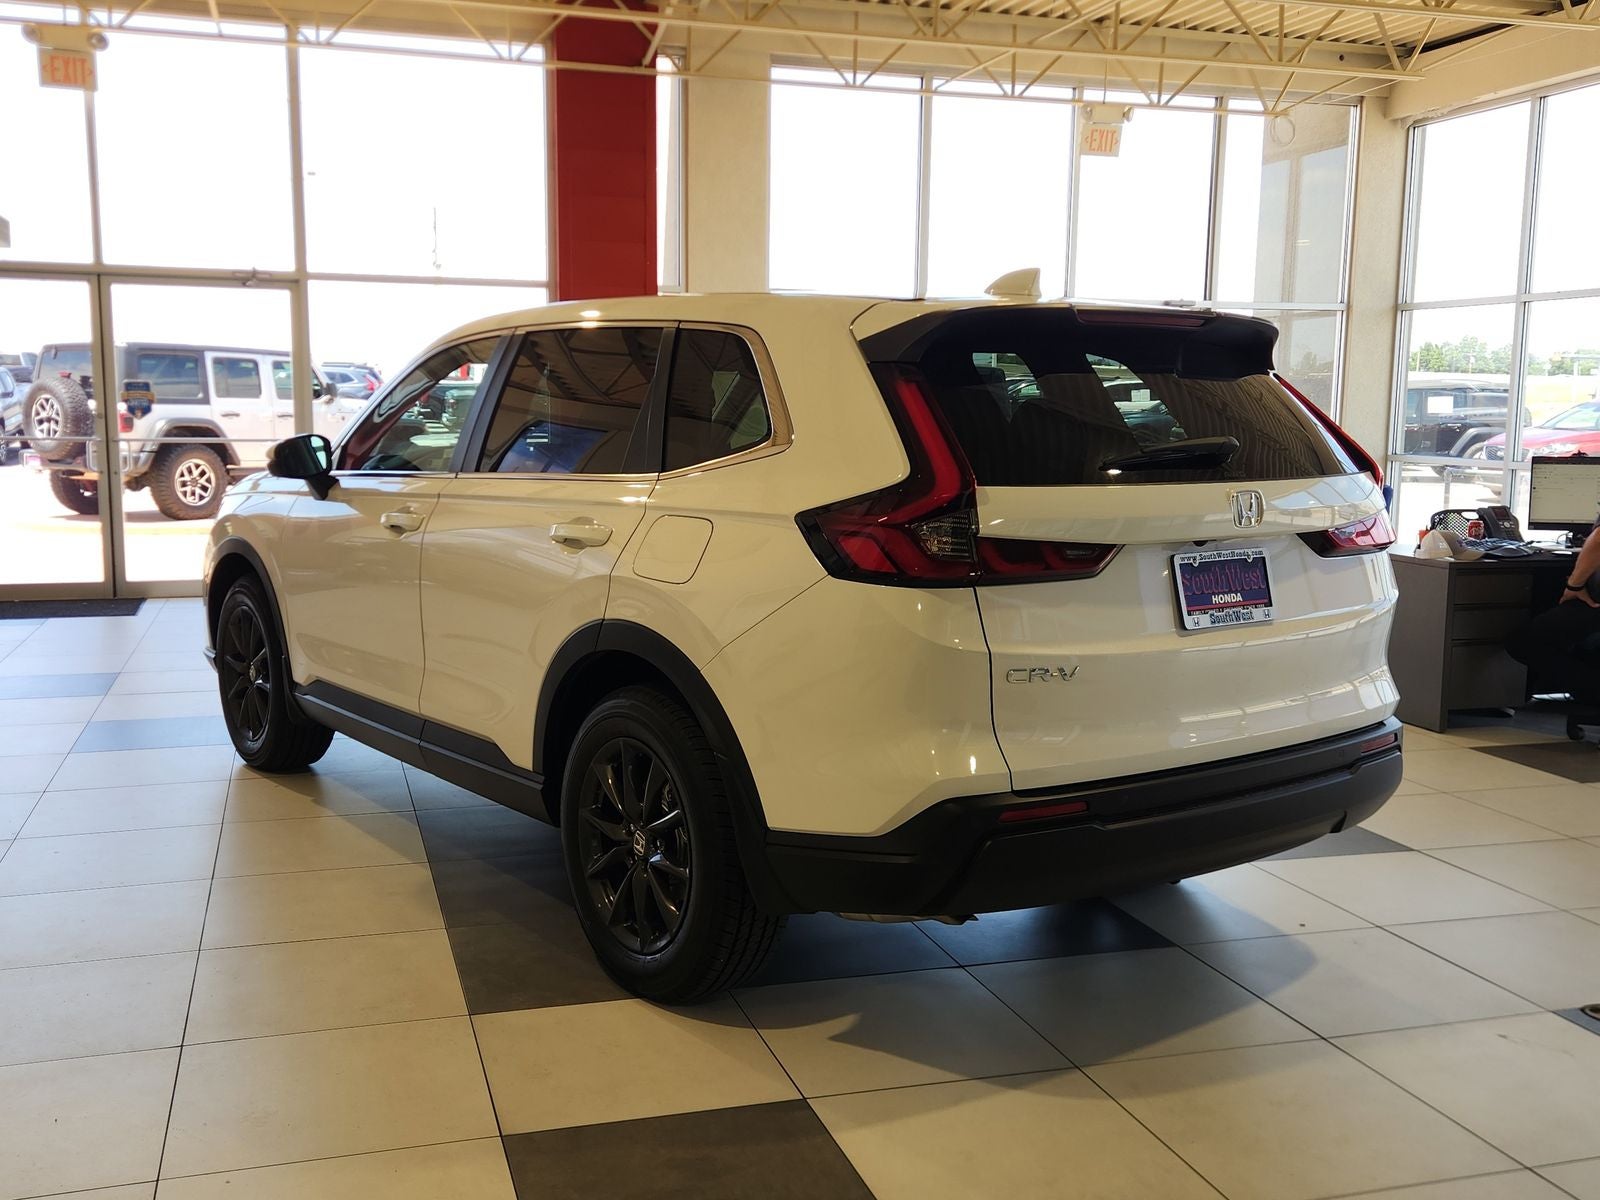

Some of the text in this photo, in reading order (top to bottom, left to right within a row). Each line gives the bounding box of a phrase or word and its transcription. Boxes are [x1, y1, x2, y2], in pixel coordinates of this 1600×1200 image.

[49, 54, 88, 84] EXIT
[1088, 127, 1117, 152] EXIT
[1182, 563, 1267, 596] SouthWest
[1212, 592, 1243, 604] HONDA
[1209, 609, 1255, 625] SouthWest
[1006, 664, 1080, 684] CR-V
